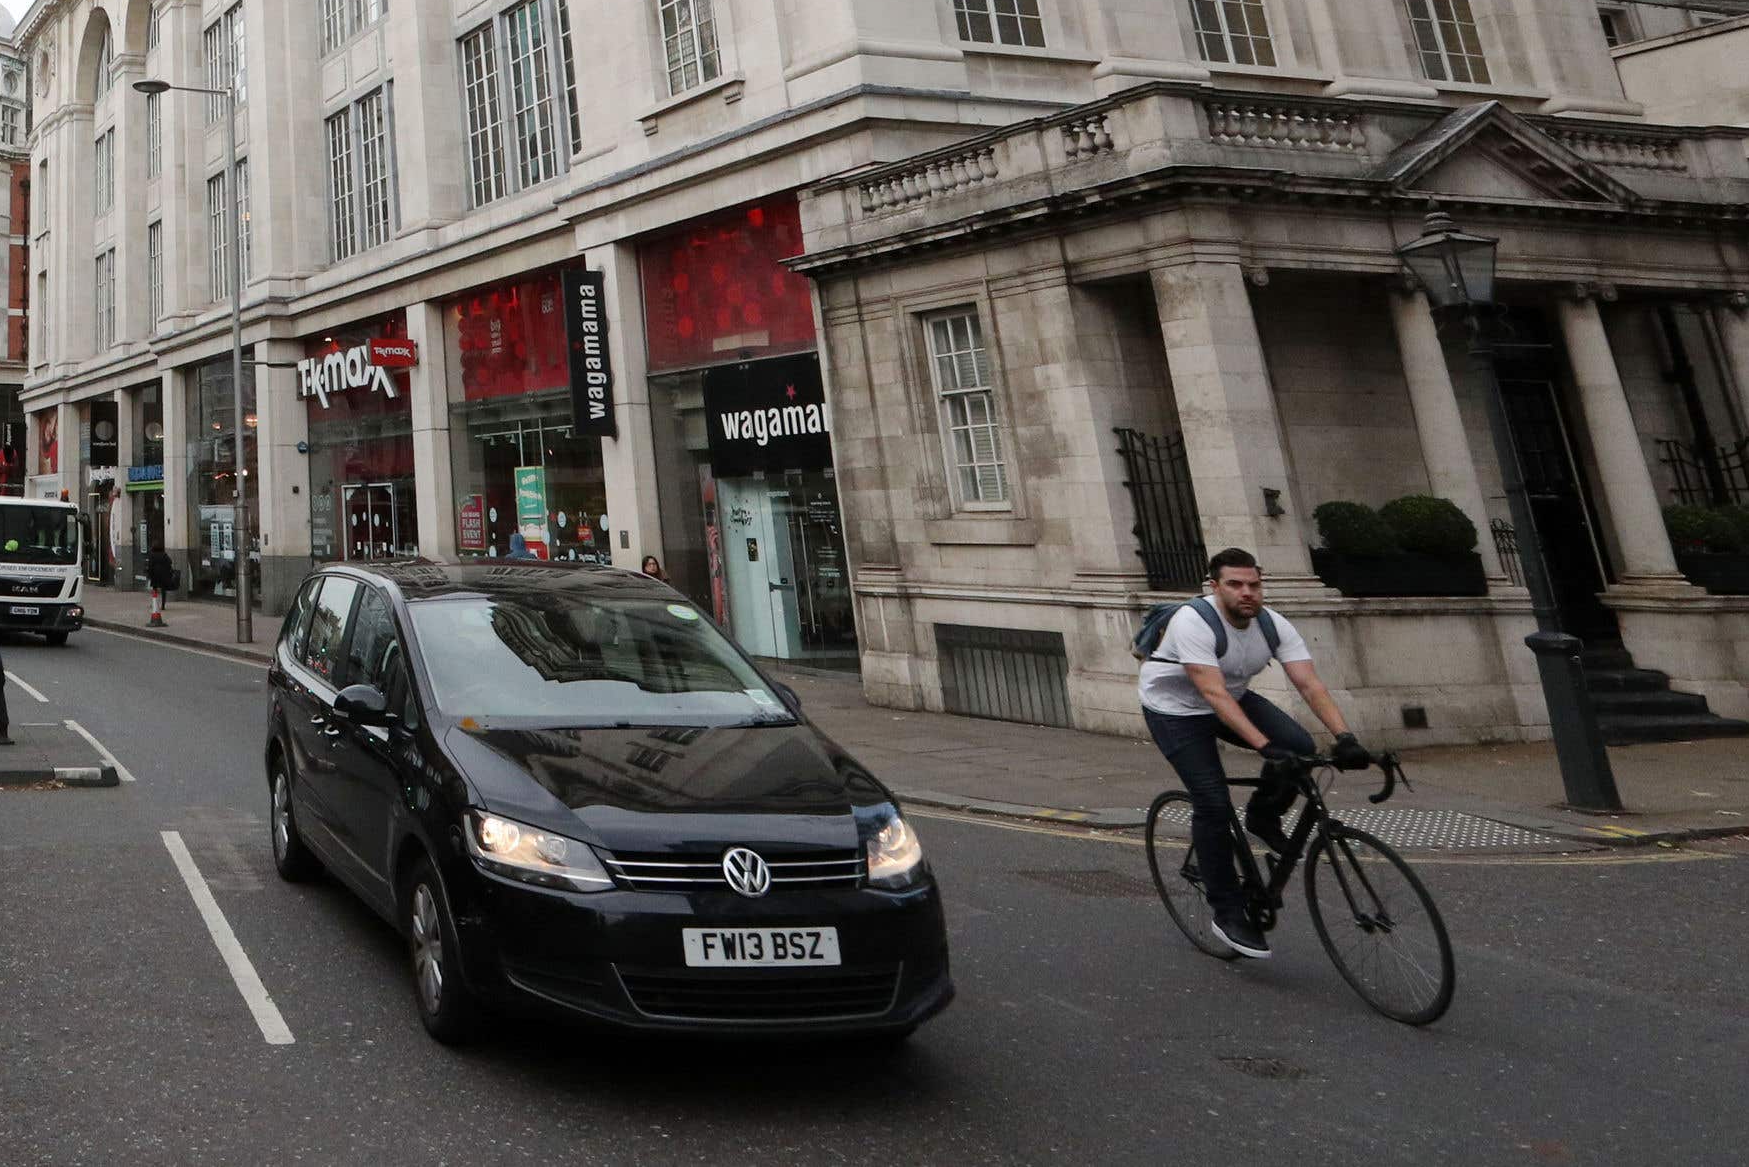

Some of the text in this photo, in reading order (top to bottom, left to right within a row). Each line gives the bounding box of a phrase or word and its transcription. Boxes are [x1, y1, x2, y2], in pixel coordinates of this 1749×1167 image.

[579, 284, 607, 420] wagamama
[721, 402, 831, 446] wagama
[702, 932, 824, 961] FW13 BSZ
